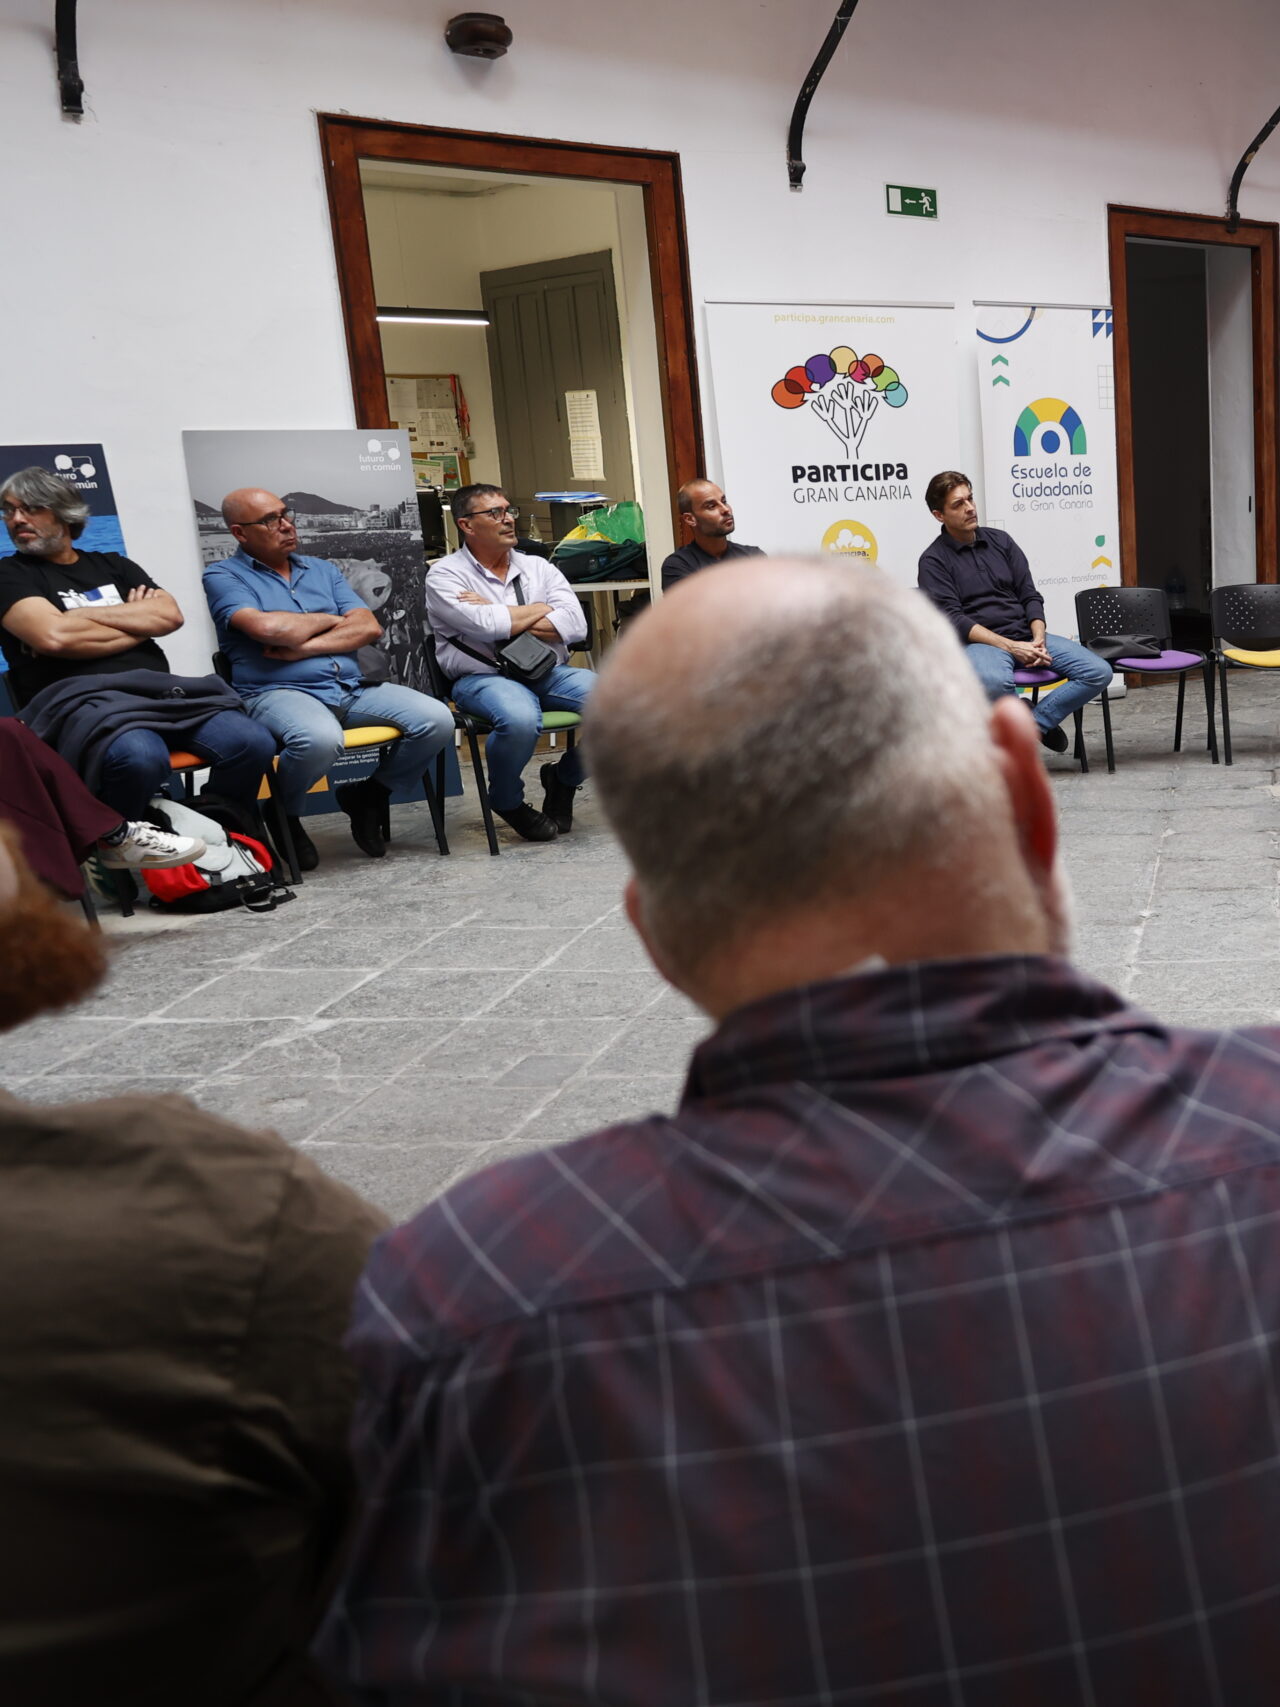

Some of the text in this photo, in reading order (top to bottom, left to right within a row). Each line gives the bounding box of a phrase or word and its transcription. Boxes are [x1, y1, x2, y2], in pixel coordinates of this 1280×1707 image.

[359, 454, 385, 463] futuro
[372, 463, 401, 472] común
[1011, 461, 1092, 479] Escuela de
[793, 485, 912, 503] GRAN CANARIA
[1012, 480, 1093, 498] Ciudadanía
[1013, 498, 1093, 512] de Gran Canaria
